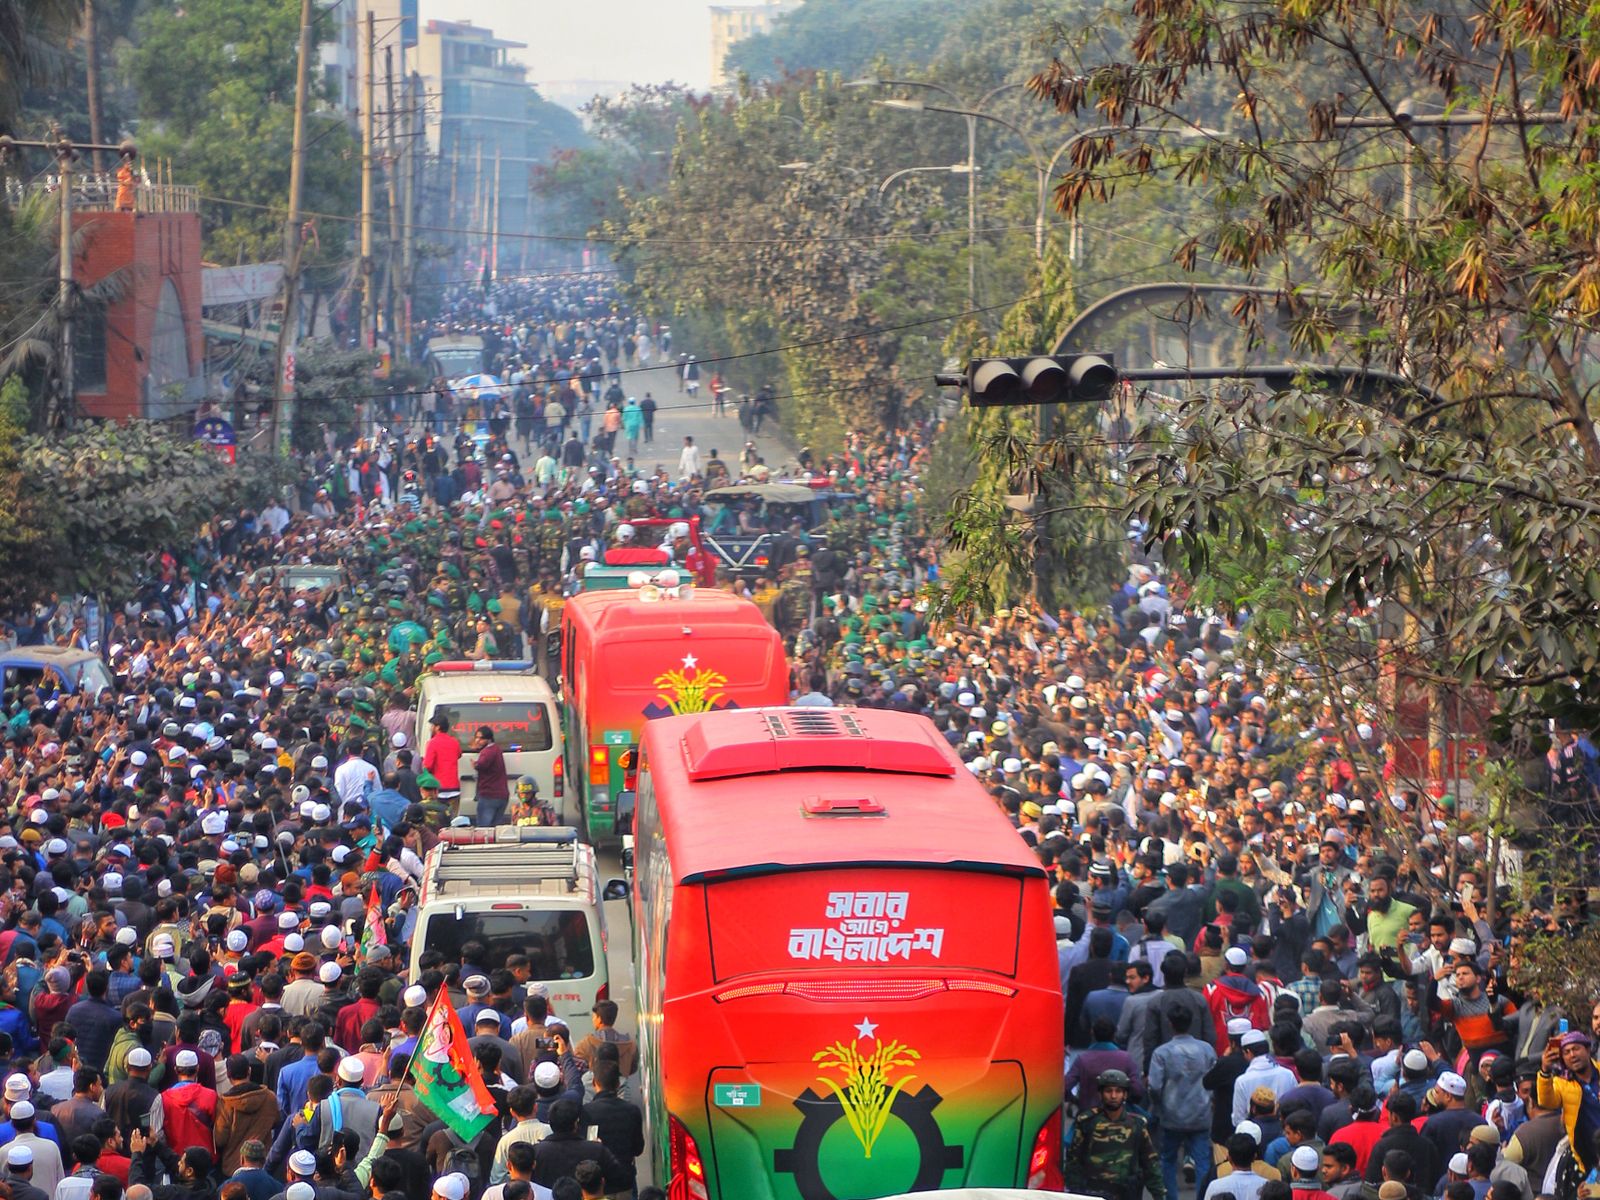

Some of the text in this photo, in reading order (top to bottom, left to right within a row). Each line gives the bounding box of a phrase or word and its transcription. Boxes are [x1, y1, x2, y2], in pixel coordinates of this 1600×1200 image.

[825, 892, 909, 928] সবার
[840, 919, 889, 936] আগে
[787, 928, 944, 963] বাংলাদেশ
